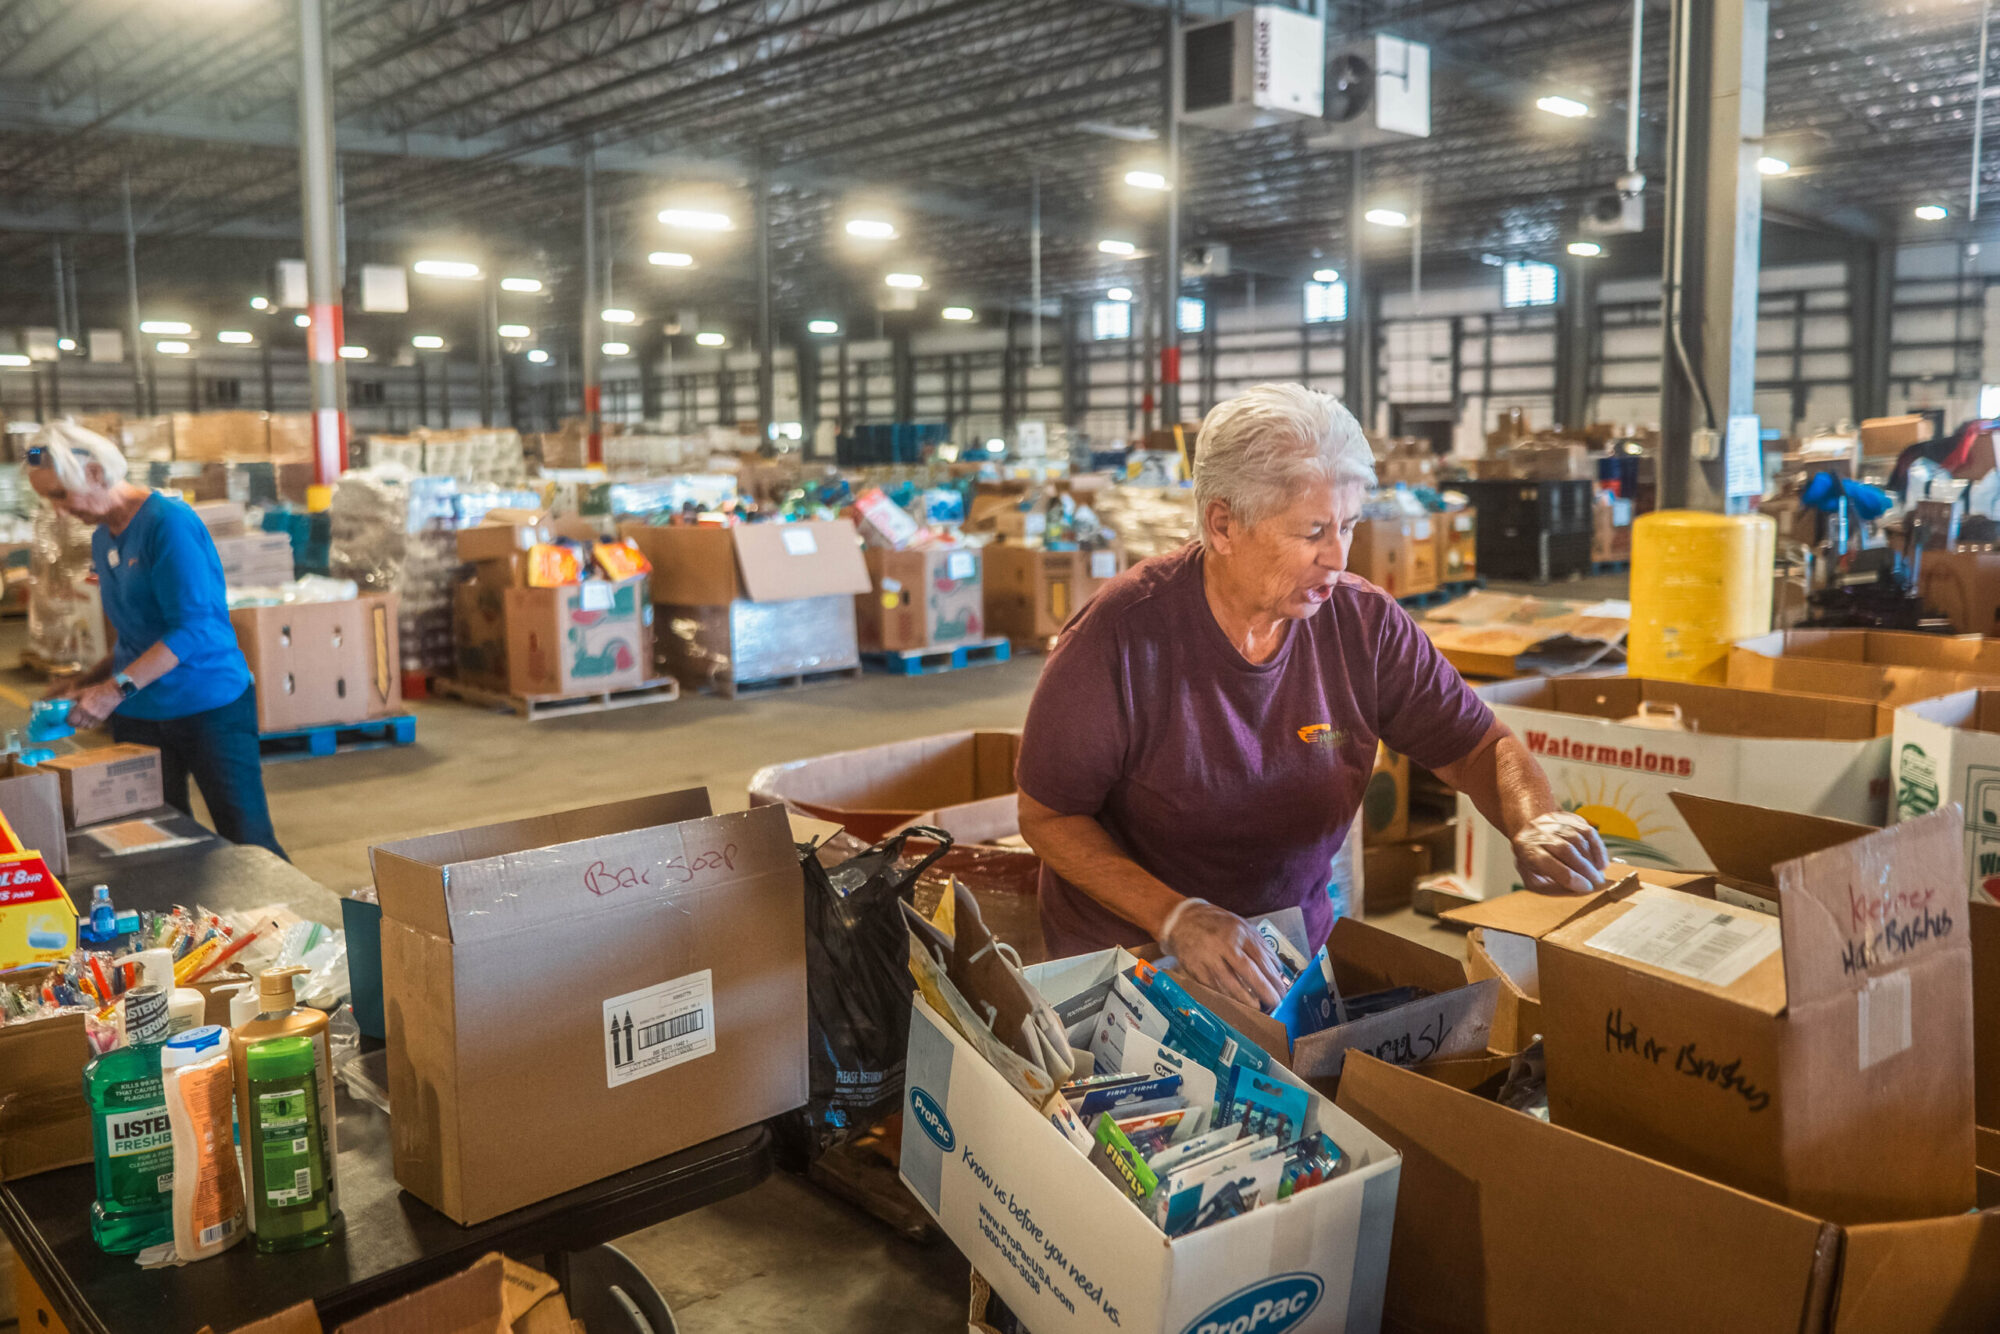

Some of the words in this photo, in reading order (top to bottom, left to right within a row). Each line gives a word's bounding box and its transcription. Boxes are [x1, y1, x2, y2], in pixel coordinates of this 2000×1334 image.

[1525, 730, 1692, 776] Watermelons
[584, 861, 650, 896] Bar
[836, 1070, 859, 1084] PLEASE
[1106, 1088, 1127, 1097] FIRM
[914, 1095, 950, 1142] ProPac
[115, 1132, 172, 1152] FRESHB
[1105, 1142, 1146, 1197] FIREFLY
[962, 1145, 993, 1189] Know
[994, 1183, 1007, 1204] us
[1008, 1194, 1043, 1243] before
[1044, 1239, 1068, 1270] you
[1069, 1264, 1103, 1306] need
[1103, 1300, 1121, 1327] us.
[978, 1202, 1075, 1314] www.ProPacUSA.com
